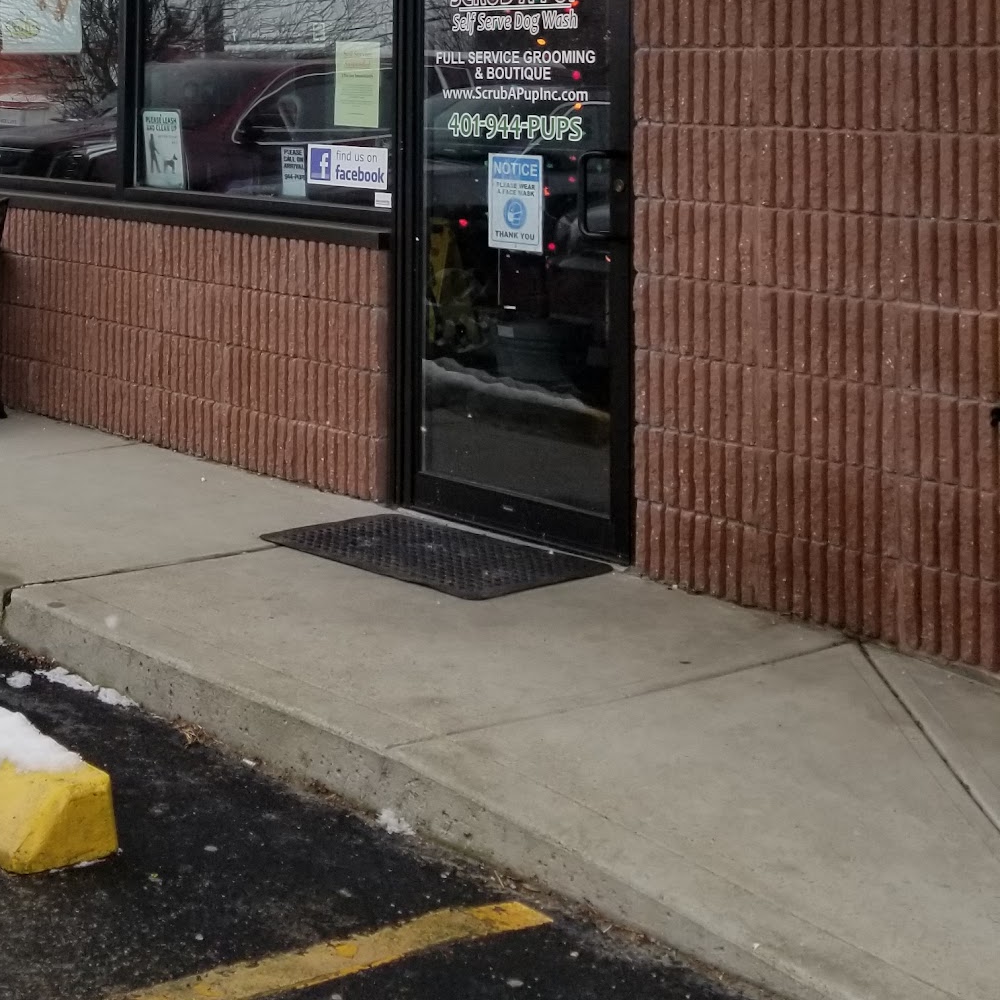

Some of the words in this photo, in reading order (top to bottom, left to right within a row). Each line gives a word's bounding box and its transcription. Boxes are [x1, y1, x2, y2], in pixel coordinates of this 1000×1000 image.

[452, 12, 476, 36] Self
[477, 12, 512, 32] Serve
[514, 11, 540, 35] Dog
[542, 8, 578, 30] Wash
[436, 52, 465, 64] FULL
[468, 51, 520, 64] SERVICE
[523, 50, 596, 64] GROOMING
[474, 67, 483, 80] &
[486, 66, 552, 81] BOUTIQUE
[442, 86, 588, 103] www.ScrubAPupInc.com
[448, 112, 583, 142] 401-944-PUPS
[336, 150, 352, 161] find
[354, 154, 365, 162] us
[367, 154, 378, 163] on
[335, 164, 384, 183] facebook
[494, 161, 538, 177] NOTICE
[495, 230, 519, 239] THANK
